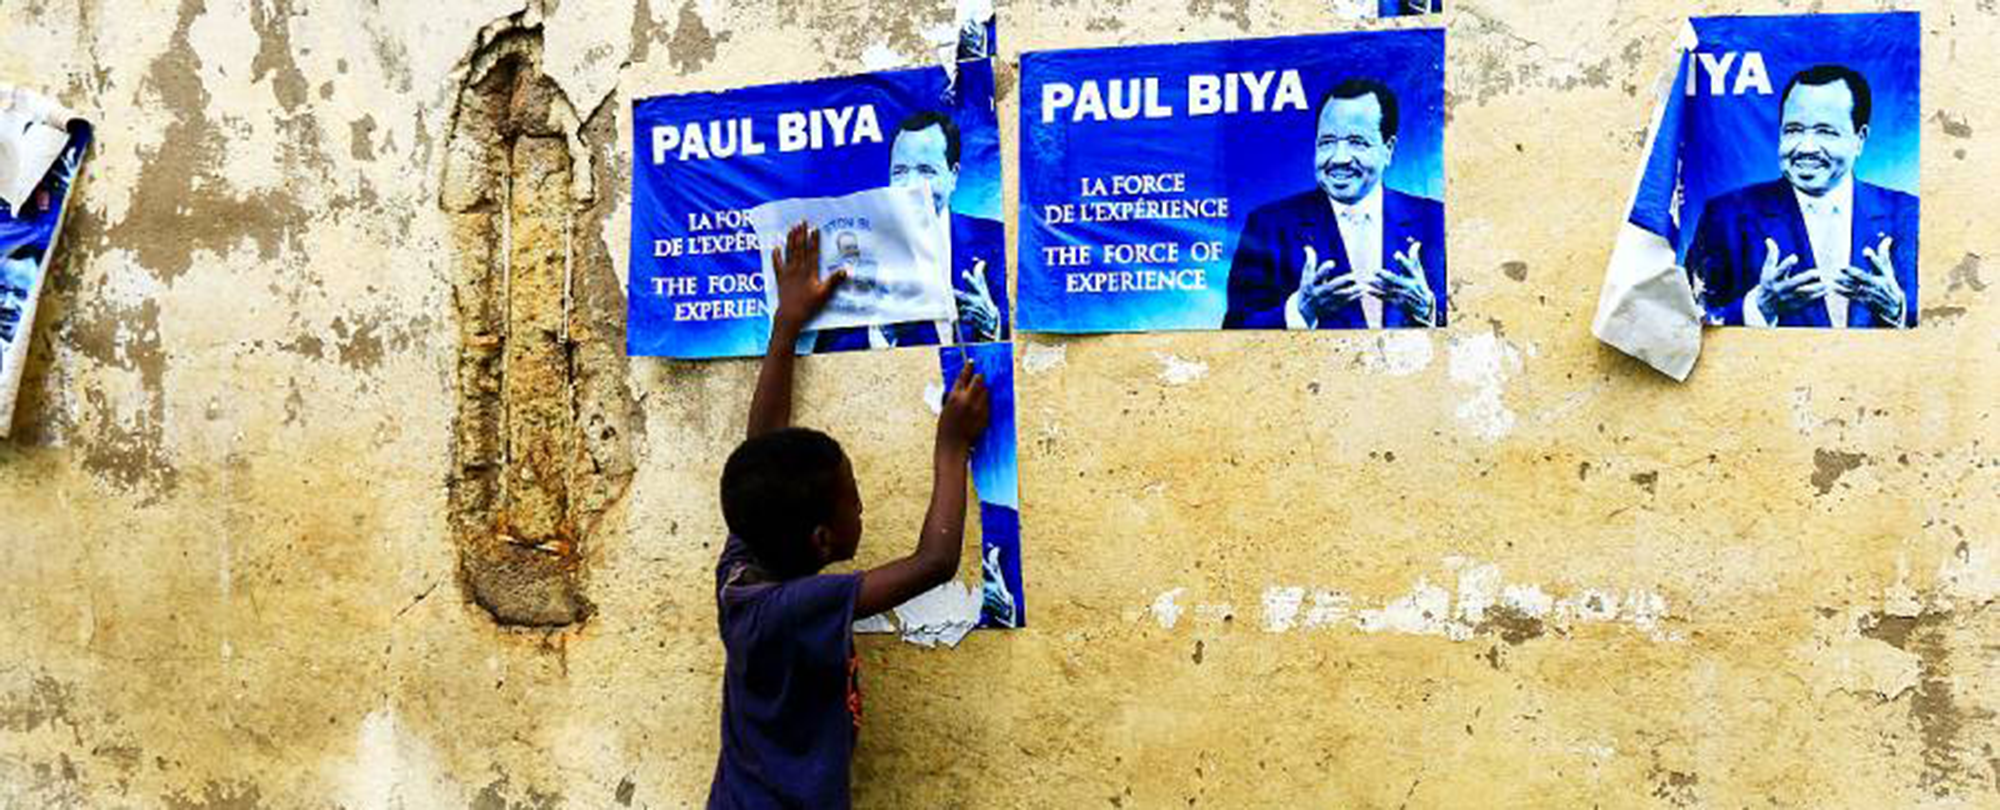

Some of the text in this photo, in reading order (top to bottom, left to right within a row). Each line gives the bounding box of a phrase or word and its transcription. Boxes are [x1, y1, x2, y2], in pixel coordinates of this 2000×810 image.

[1685, 51, 1774, 96] IYA
[1041, 69, 1308, 123] PAUL BIYA
[652, 104, 883, 165] PAUL BIYA
[1081, 173, 1185, 196] LA FORCE
[688, 209, 754, 232] LA FOR
[1044, 198, 1228, 223] DE L'EXPÉRIENCE
[654, 230, 760, 257] DE L'EXPÉR
[1042, 241, 1223, 266] THE FORCE OF
[651, 272, 764, 297] THE FORC
[1066, 269, 1207, 293] EXPERIENCE
